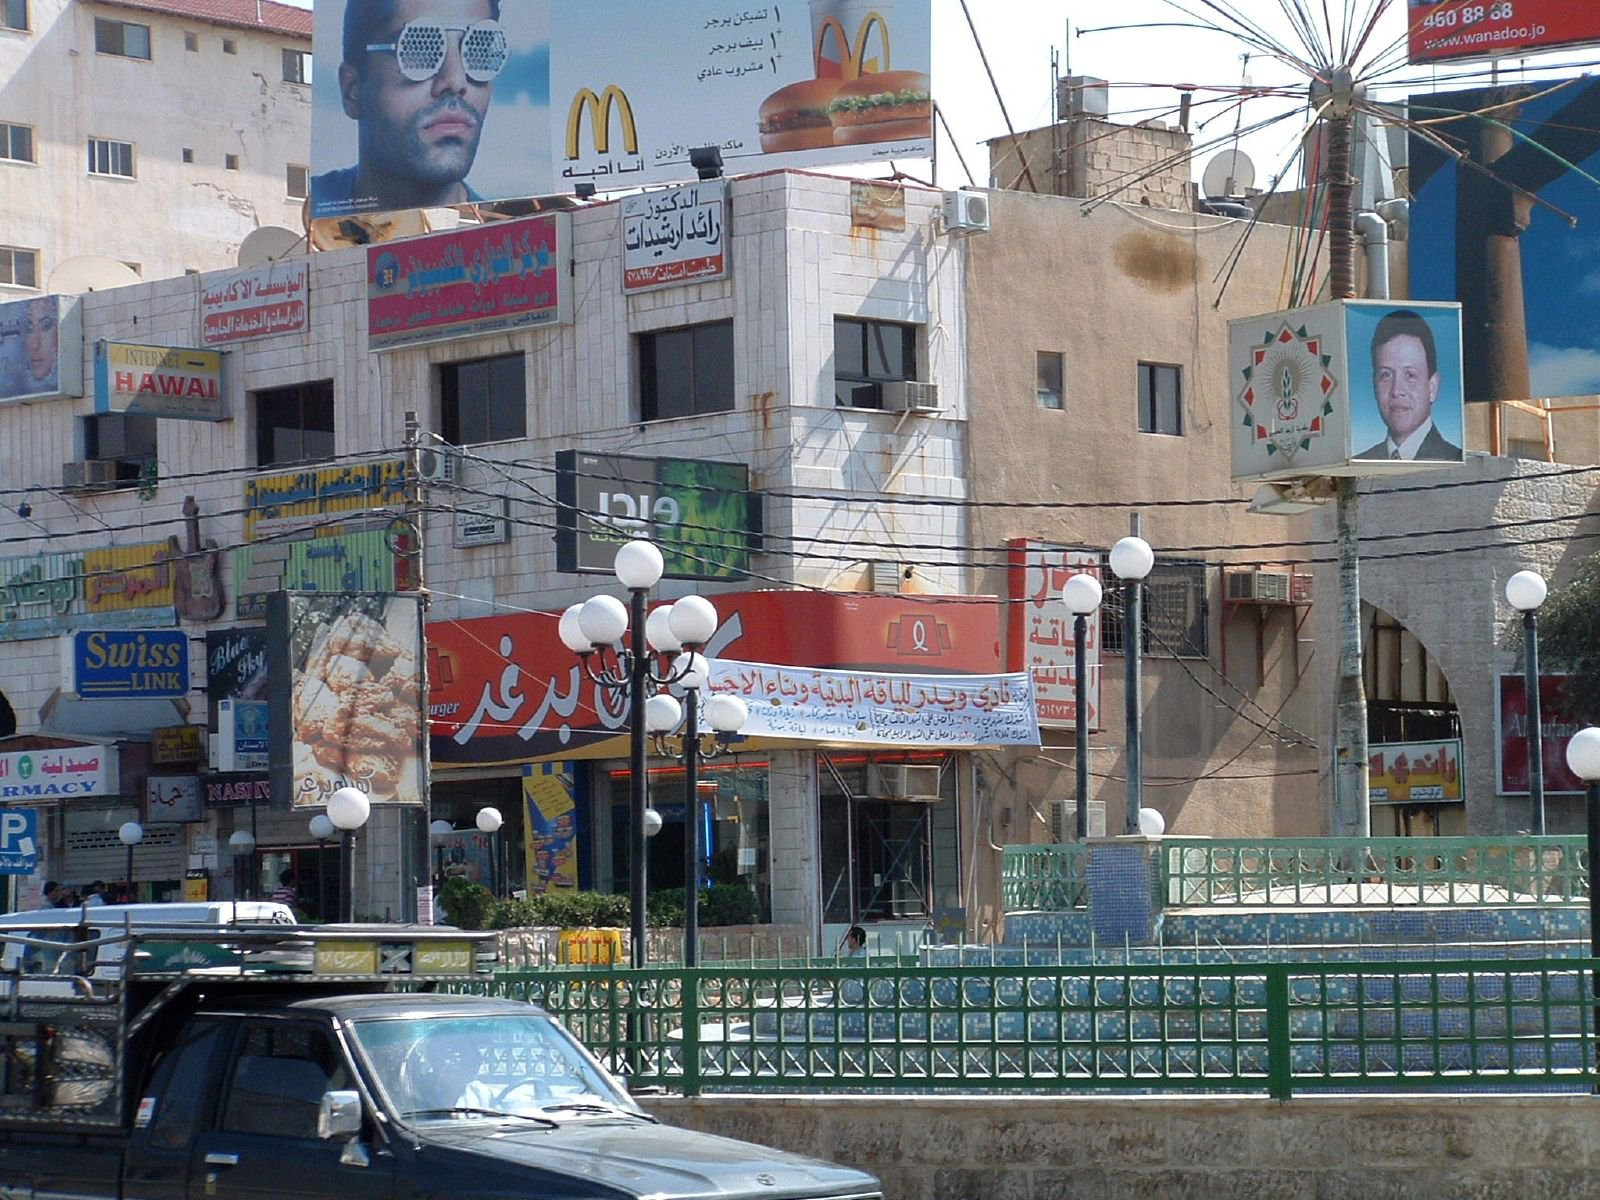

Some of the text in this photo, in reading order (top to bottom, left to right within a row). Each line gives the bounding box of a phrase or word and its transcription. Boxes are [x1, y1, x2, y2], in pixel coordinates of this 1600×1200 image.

[1424, 2, 1513, 28] 460 88 88
[1424, 24, 1546, 49] www.wanadoo.jo
[686, 207, 721, 246] رائد
[255, 271, 305, 299] المؤسسة
[125, 348, 181, 369] INTERNET
[114, 370, 218, 400] HAWAI
[85, 632, 181, 669] Swiss
[131, 672, 181, 690] LINK
[811, 672, 862, 708] البدنية
[863, 676, 912, 713] للياقة
[427, 702, 460, 717] urger
[912, 685, 968, 712] ويدر
[41, 755, 99, 778] صيدلية
[0, 781, 97, 798] RMACY
[1, 813, 28, 849] P
